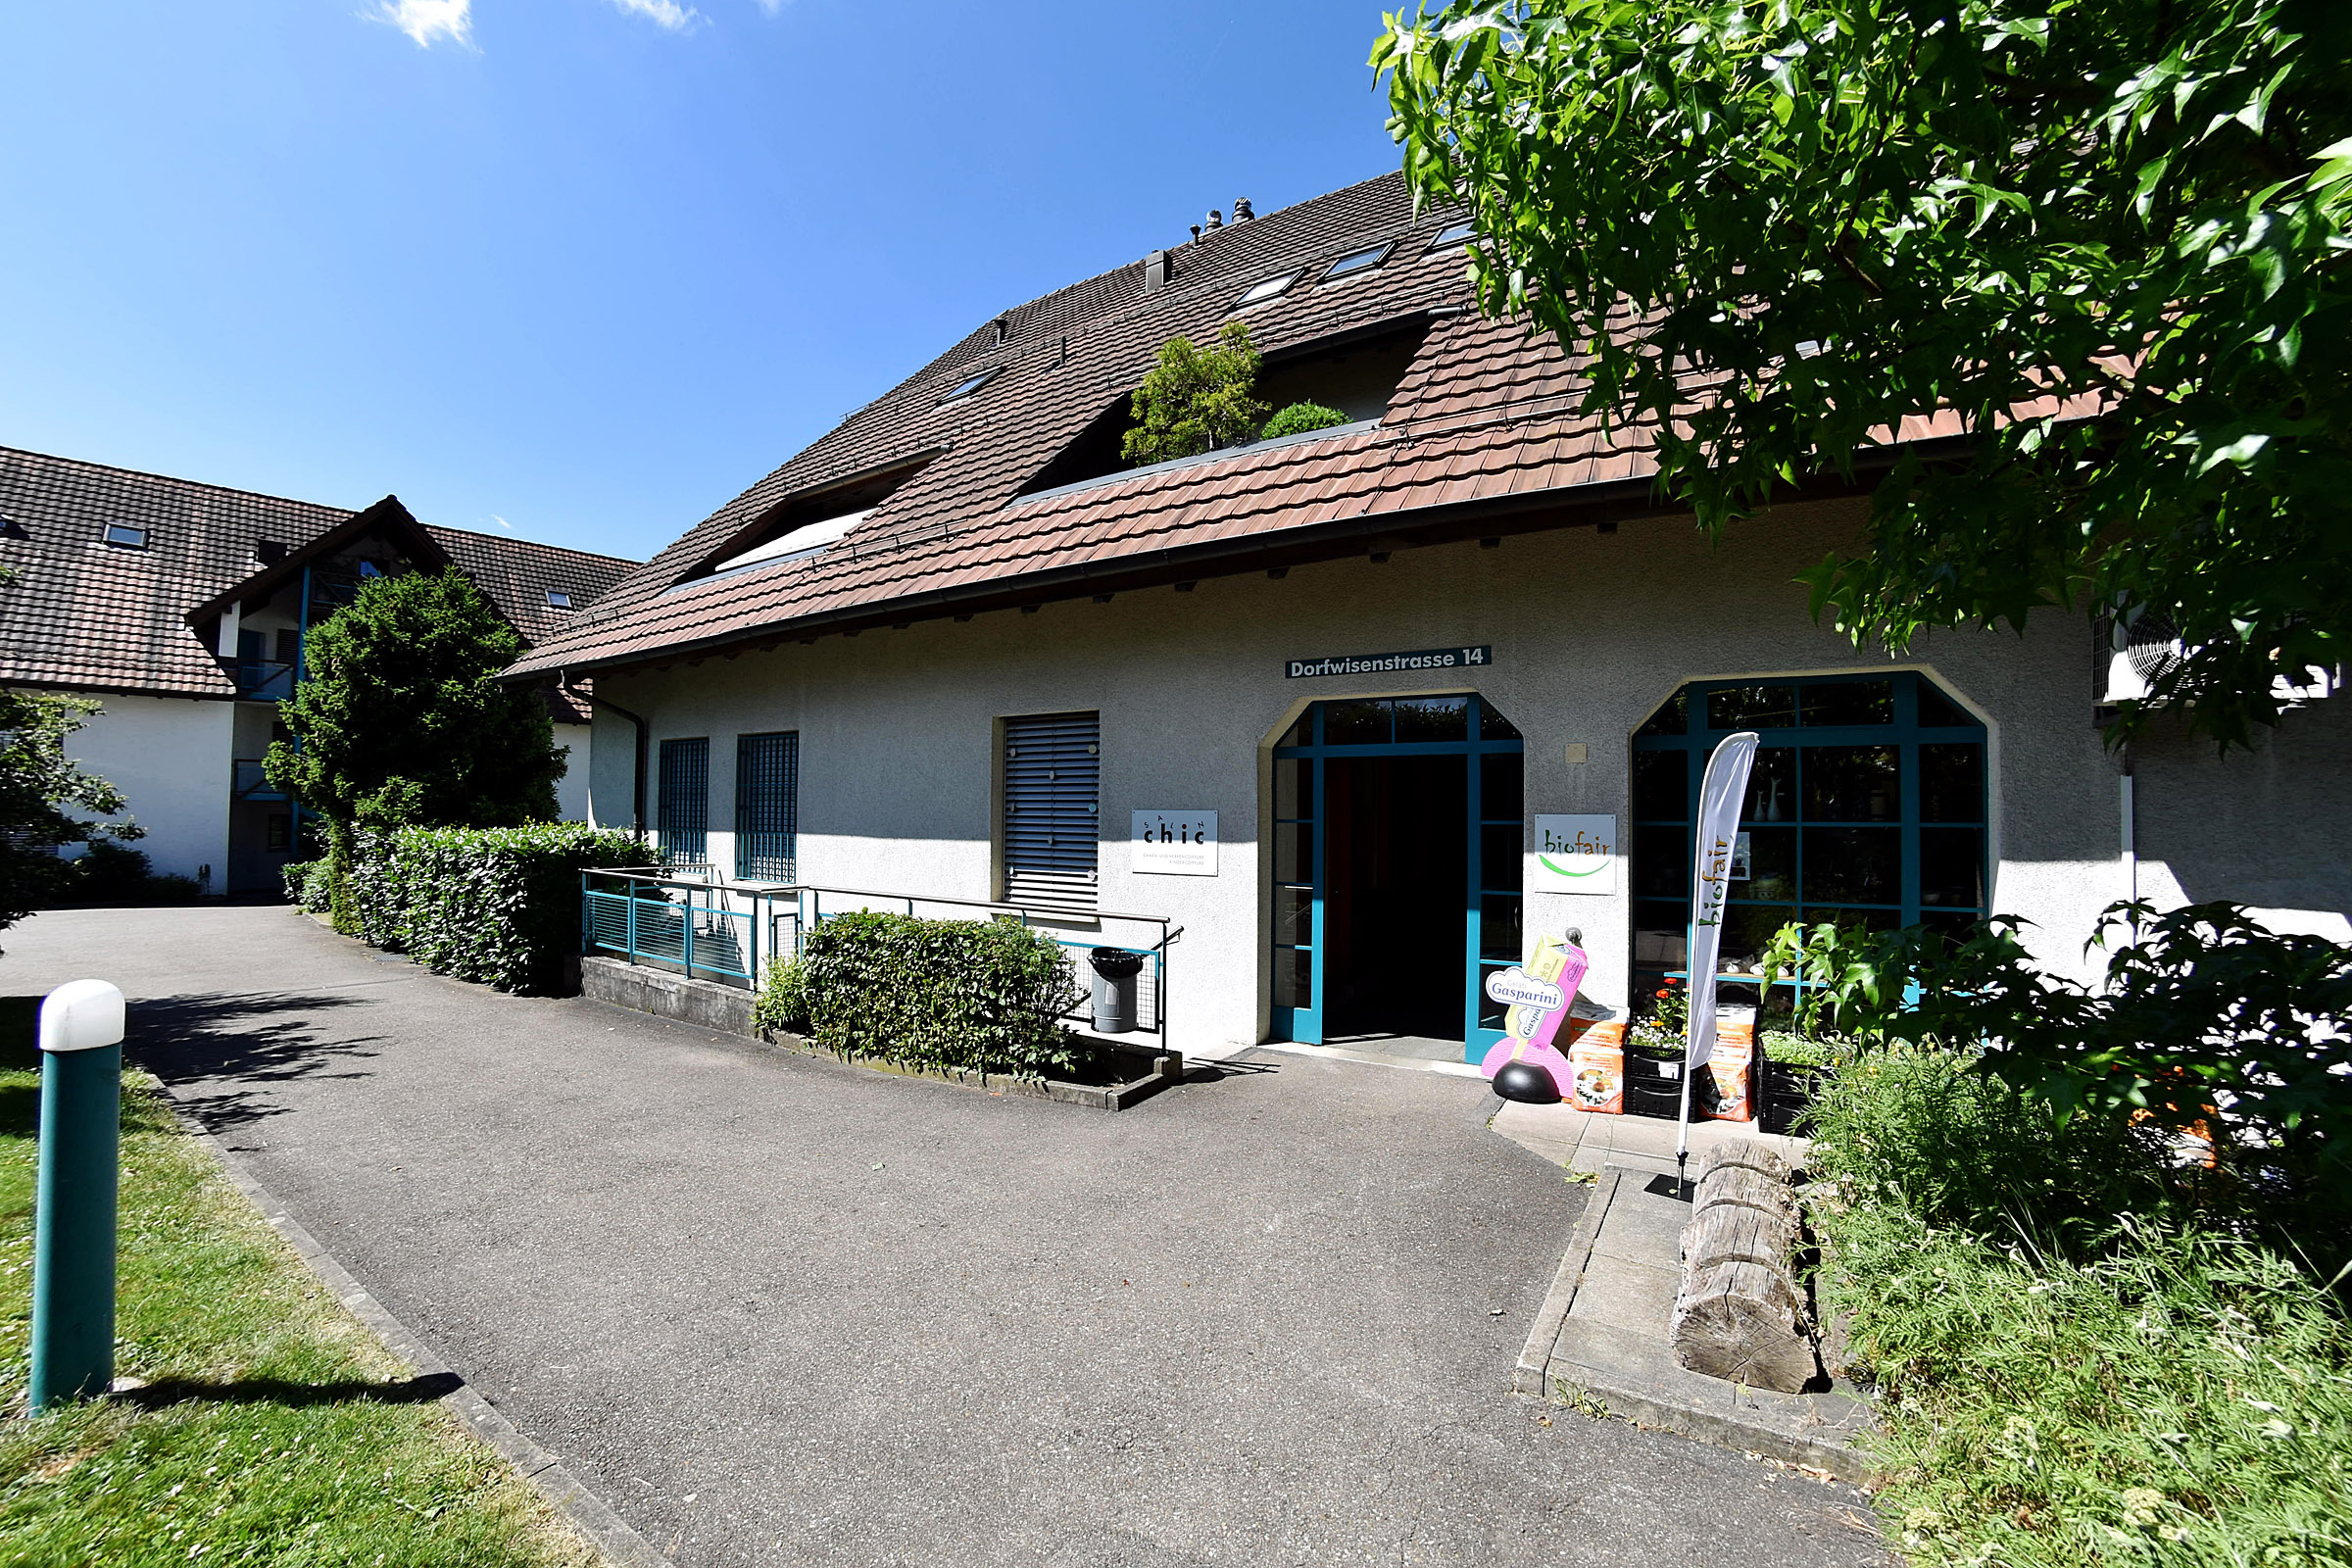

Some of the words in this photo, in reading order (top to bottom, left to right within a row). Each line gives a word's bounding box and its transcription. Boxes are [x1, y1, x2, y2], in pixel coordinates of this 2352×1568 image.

[1291, 655, 1455, 677] Dorfwisenstrasse
[1462, 648, 1484, 665] 14
[1144, 823, 1204, 845] chic
[1544, 829, 1611, 858] biofair
[1698, 836, 1728, 927] biofair
[1492, 982, 1557, 1004] Gasparini
[1507, 979, 1527, 989] Gelati
[1523, 1008, 1542, 1036] Gaspa
